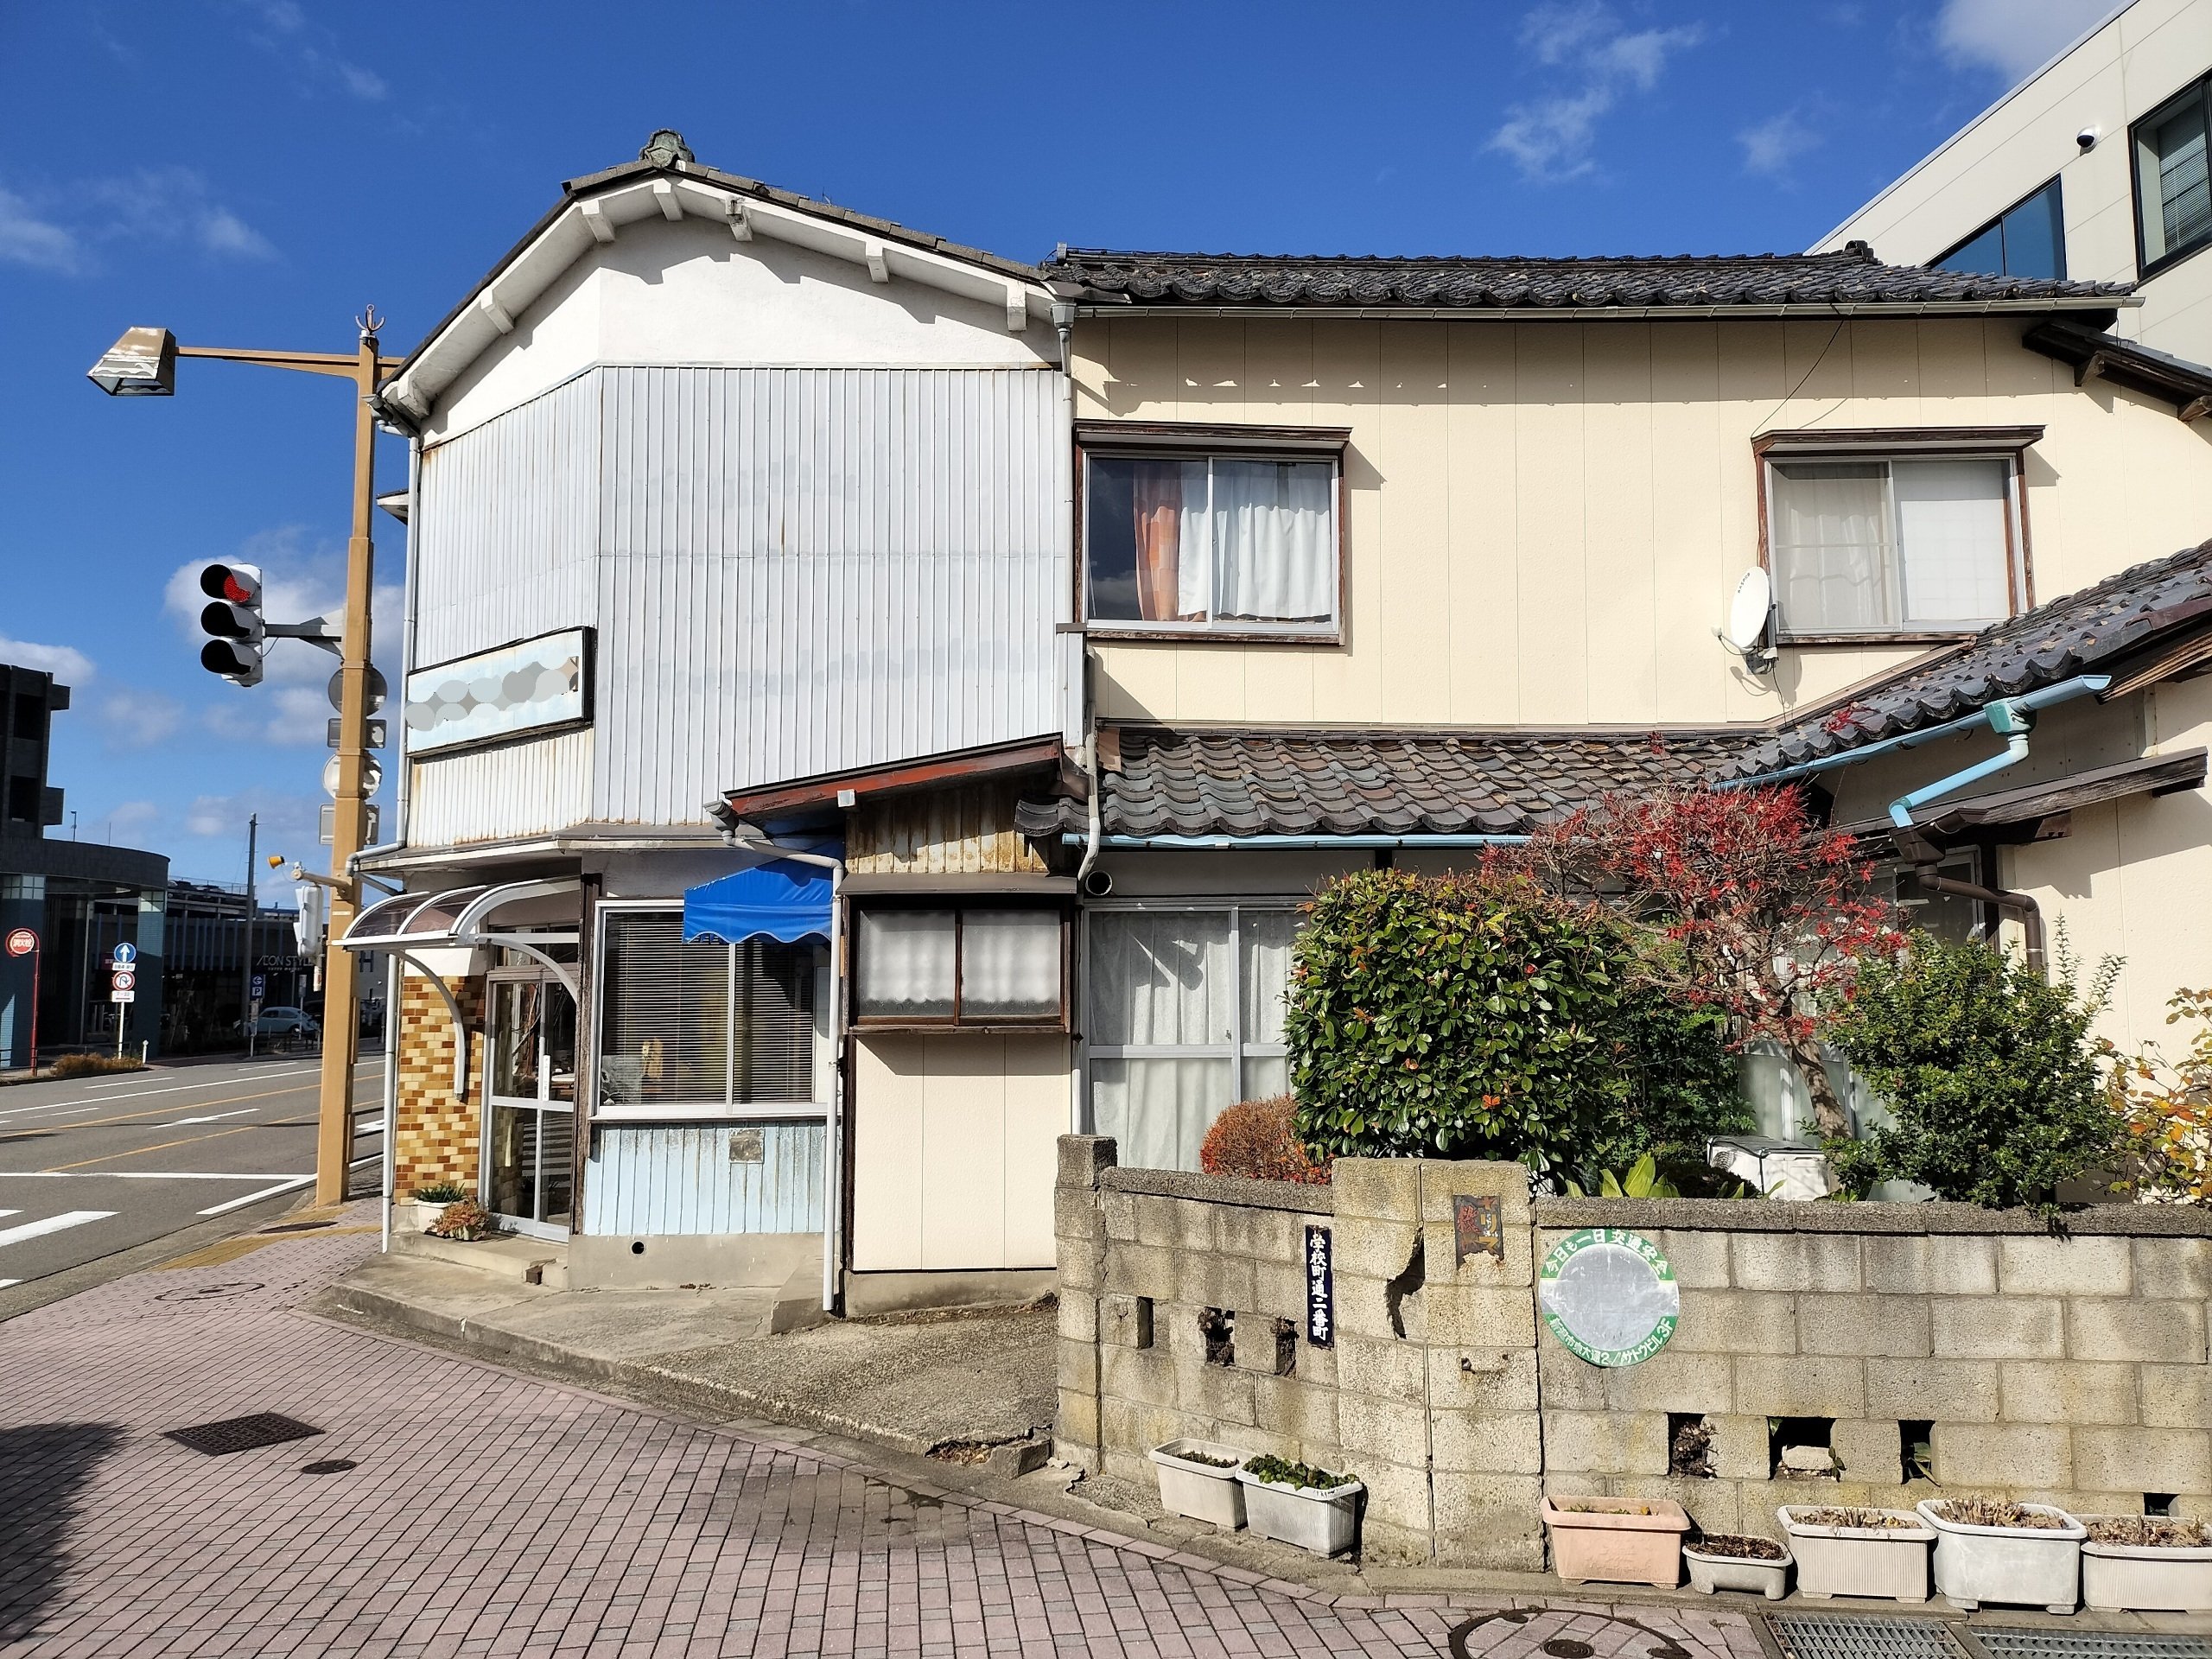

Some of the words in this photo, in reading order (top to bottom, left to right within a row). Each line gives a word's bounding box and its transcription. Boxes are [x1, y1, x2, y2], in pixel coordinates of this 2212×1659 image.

[1309, 1233, 1329, 1341] 学校町通二番町
